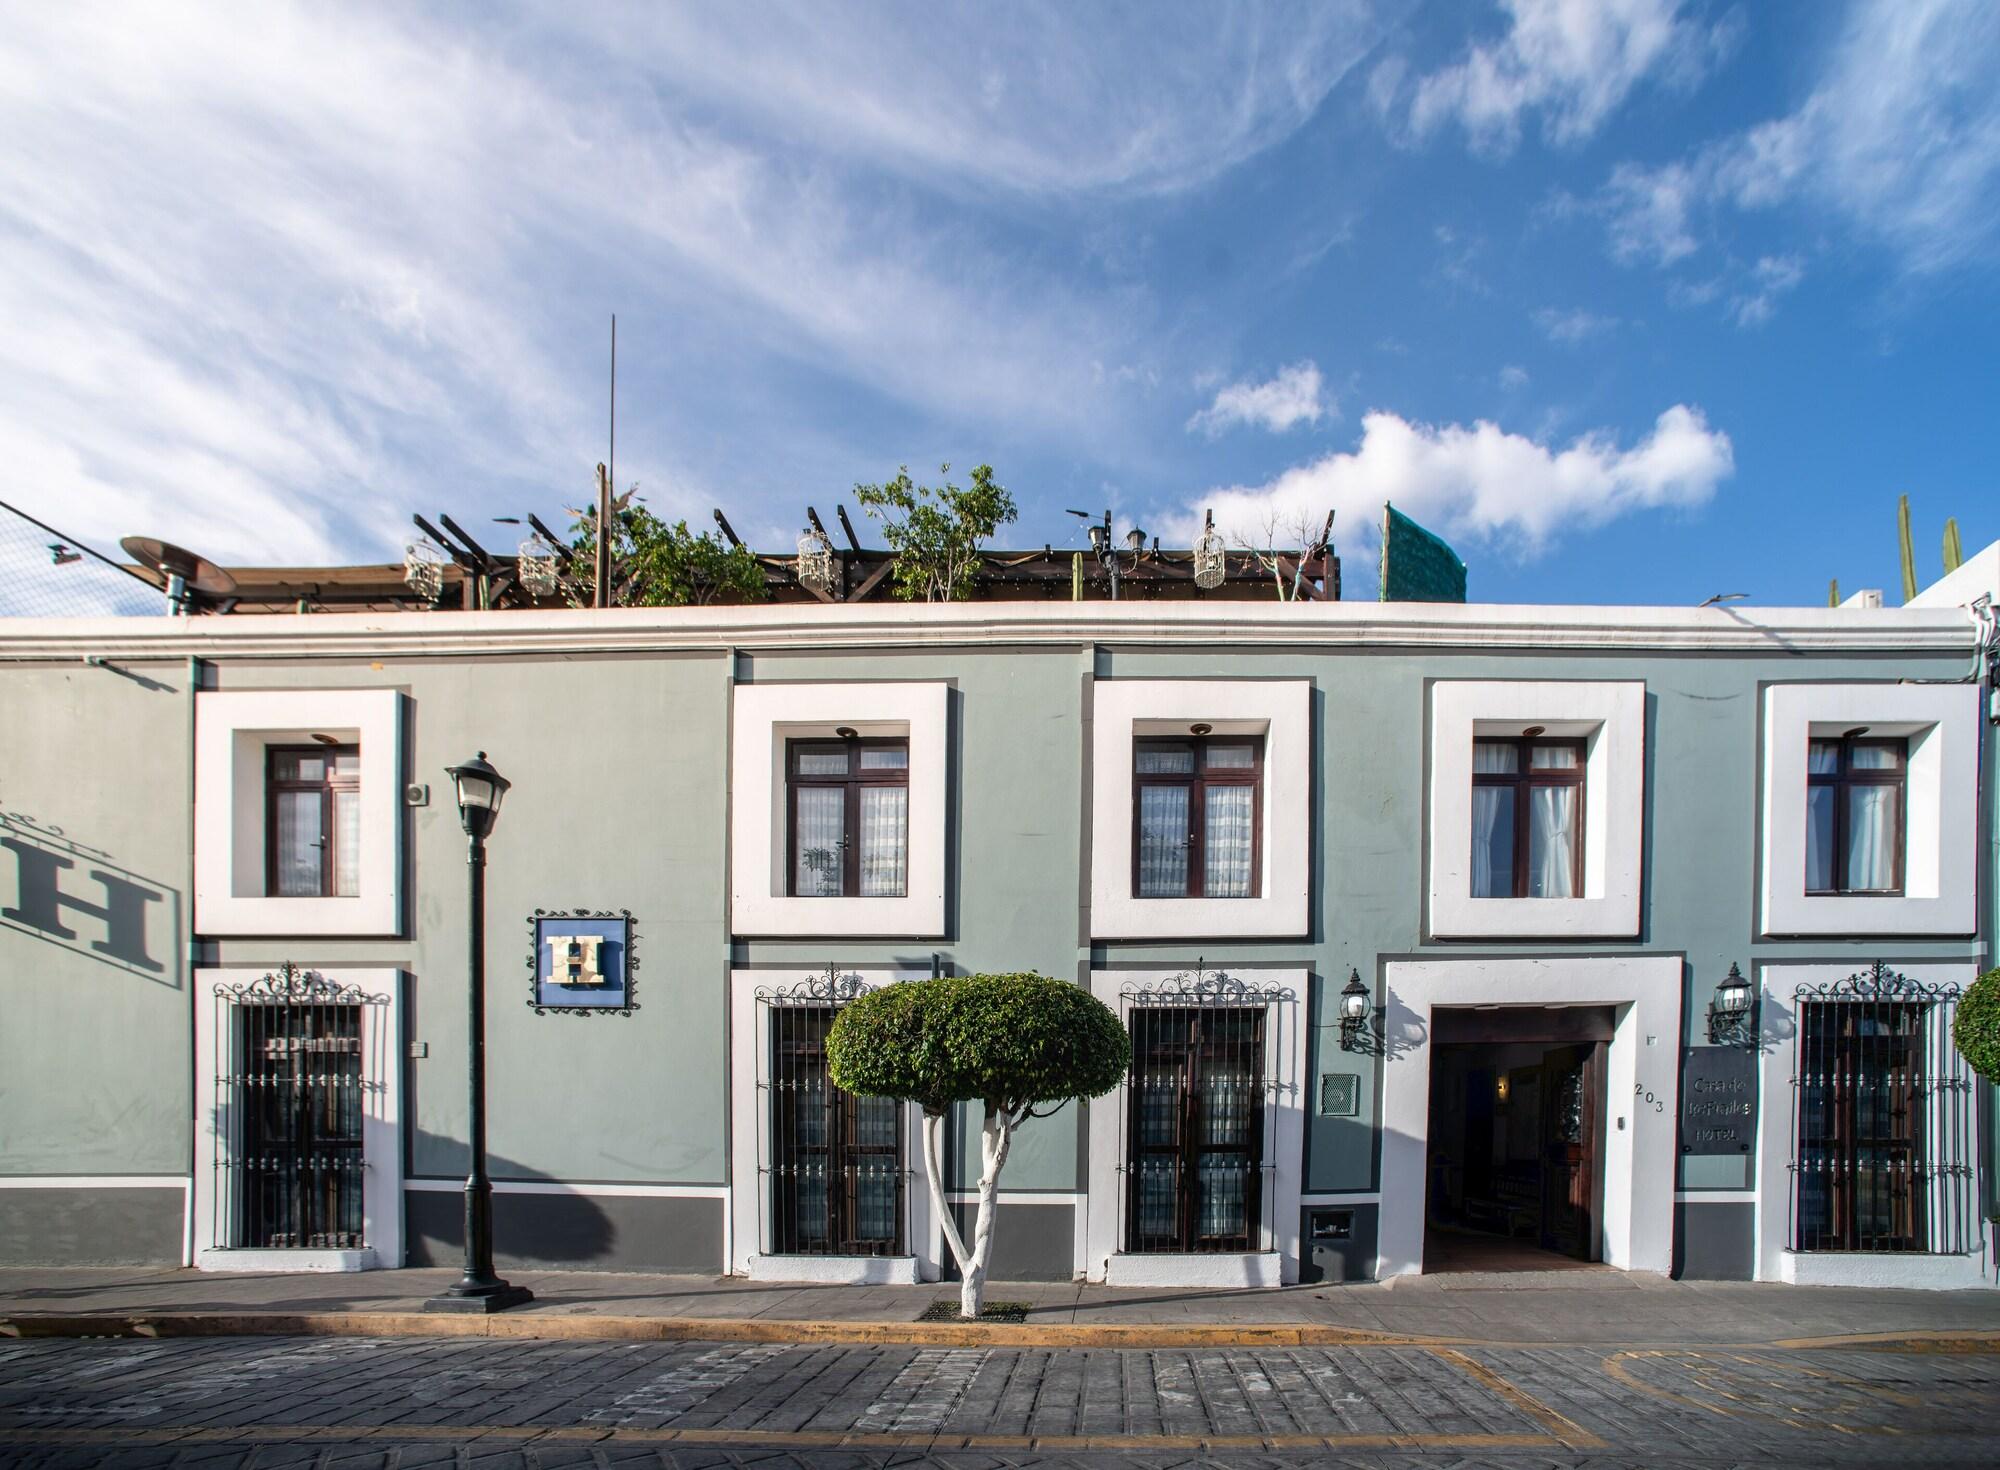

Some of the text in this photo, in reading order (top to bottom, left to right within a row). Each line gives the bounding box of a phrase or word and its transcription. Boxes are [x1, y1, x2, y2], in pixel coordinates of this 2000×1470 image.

[546, 935, 604, 984] H
[1694, 1077, 1746, 1093] Casa de
[1635, 1083, 1663, 1113] 203
[1695, 1128, 1737, 1141] HOTEL
